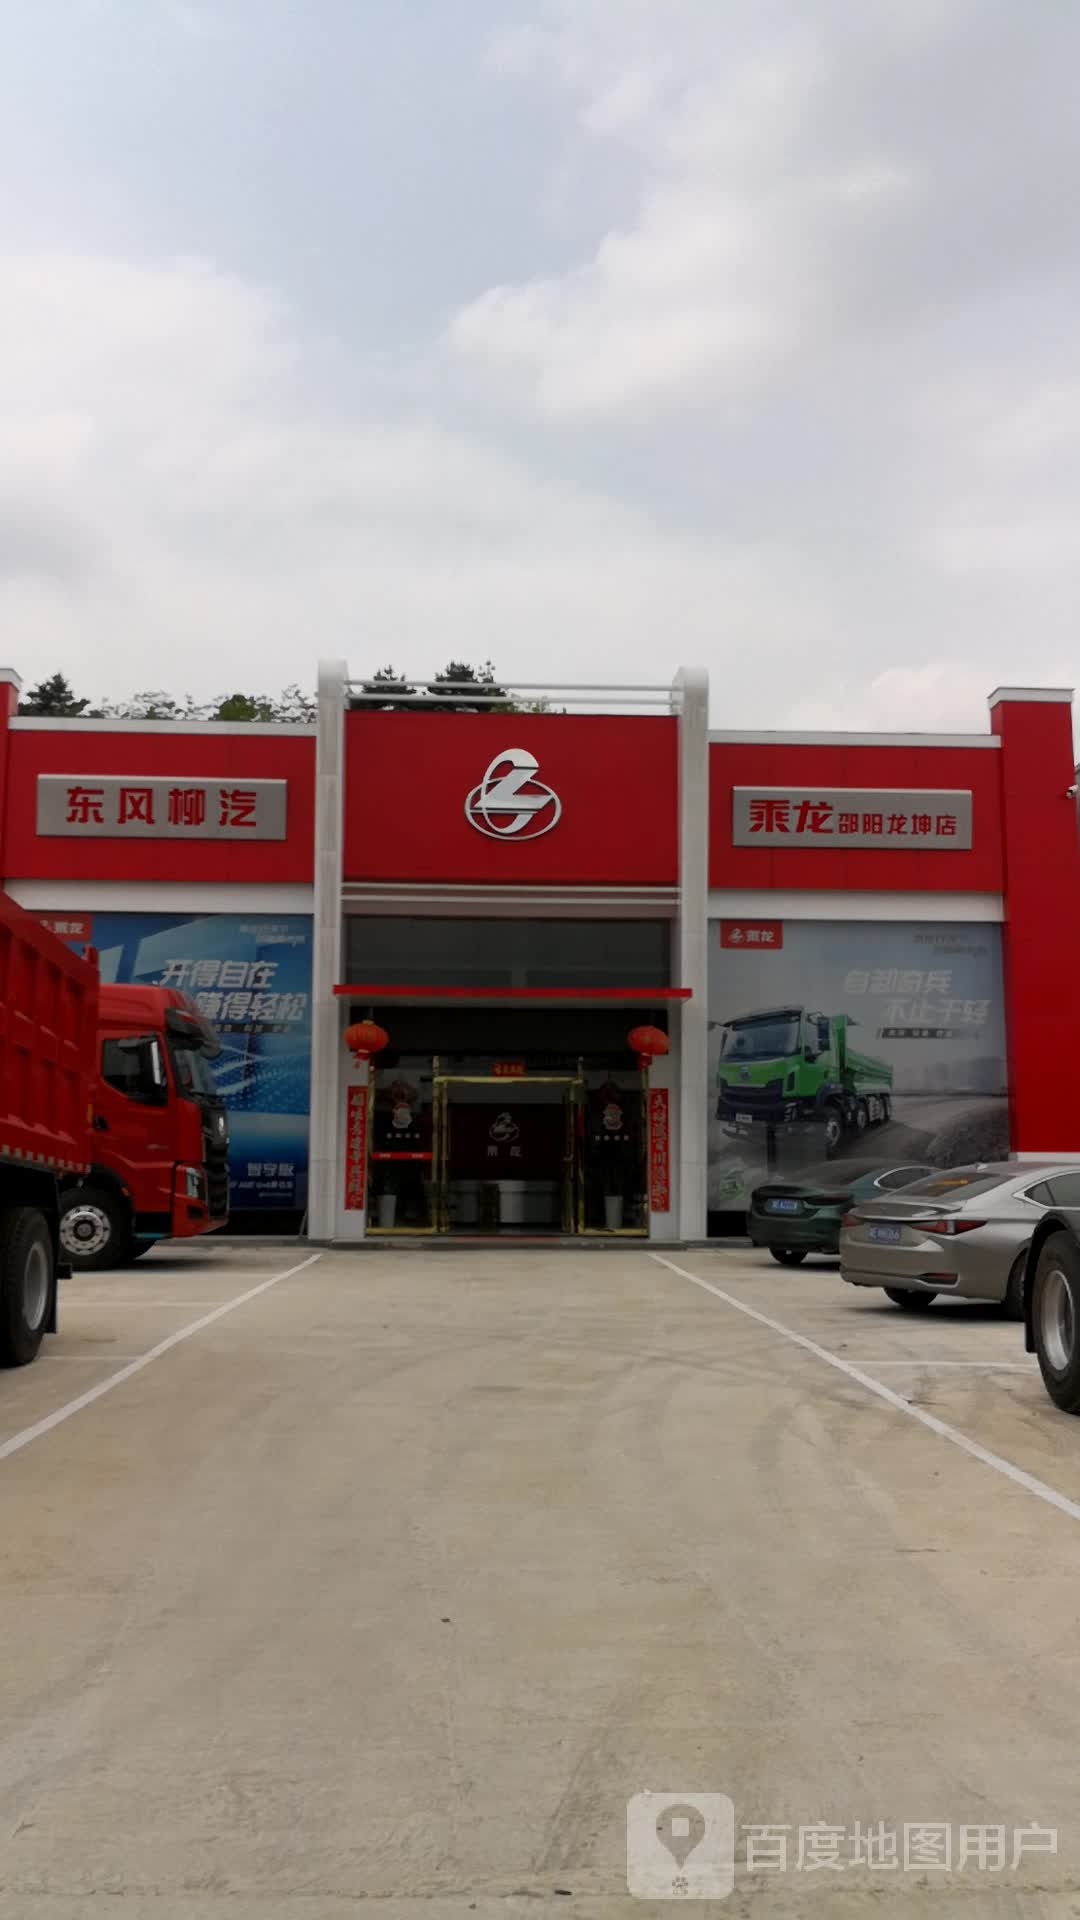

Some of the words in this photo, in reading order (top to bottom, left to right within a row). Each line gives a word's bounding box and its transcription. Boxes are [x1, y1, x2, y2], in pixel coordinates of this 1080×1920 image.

[66, 786, 257, 827] 东风柳汽
[749, 800, 834, 833] 乘龙
[838, 813, 957, 836] 邵阳龙坤店
[160, 959, 279, 989] 开得自在
